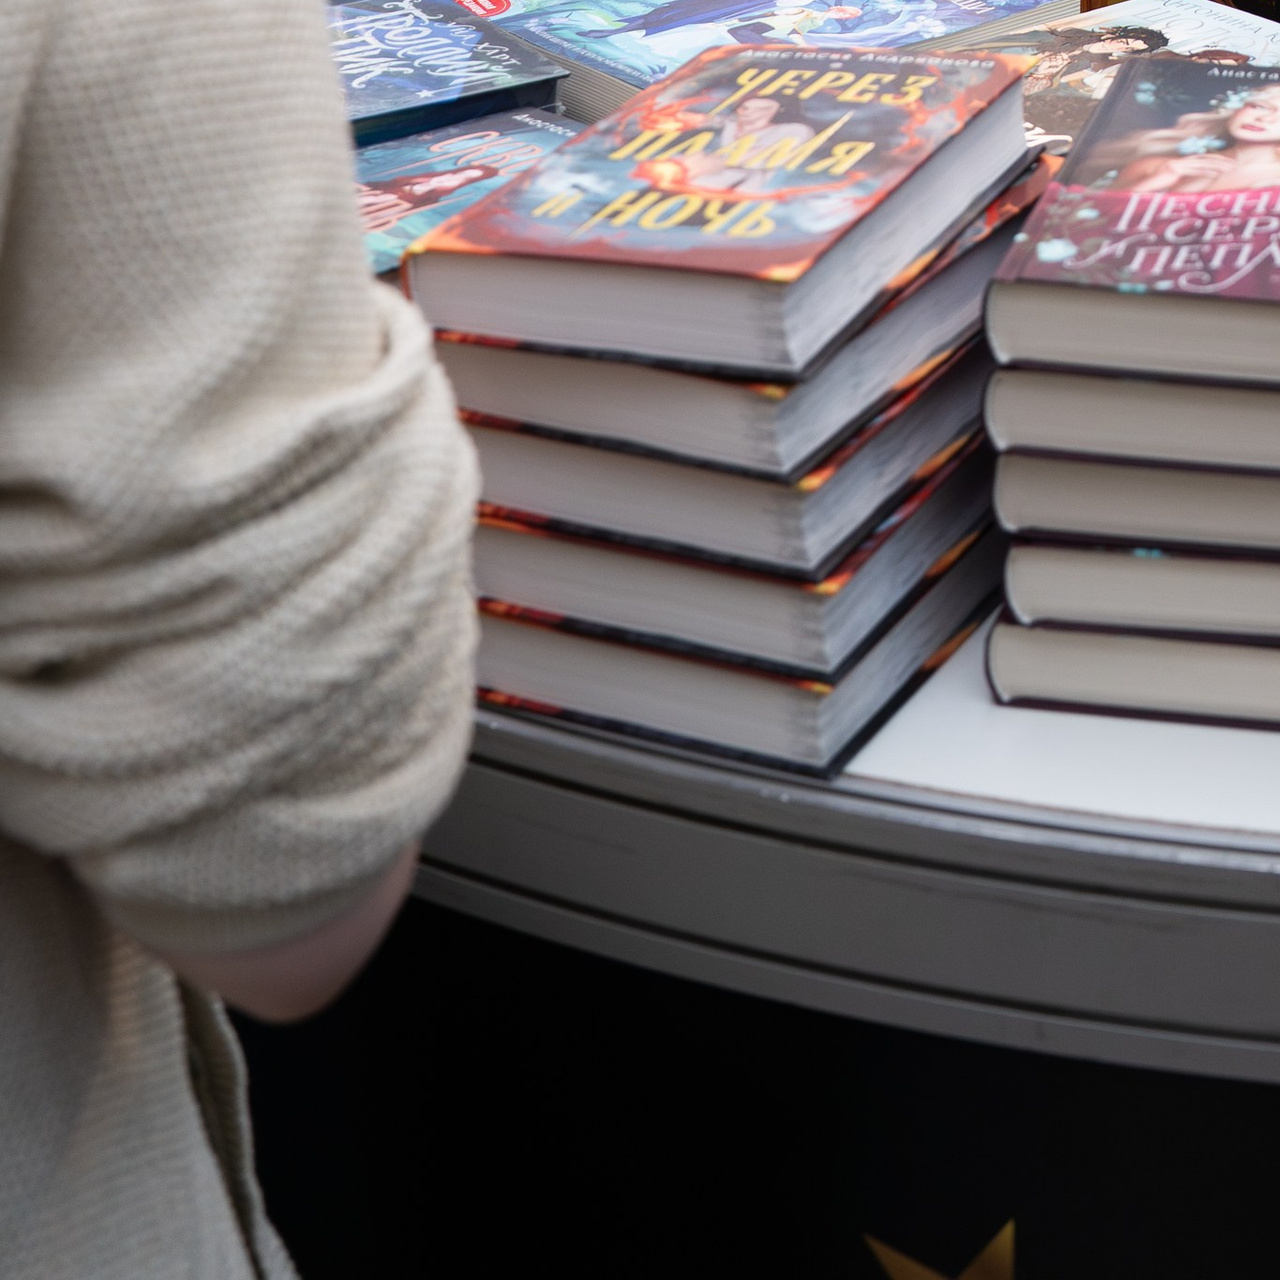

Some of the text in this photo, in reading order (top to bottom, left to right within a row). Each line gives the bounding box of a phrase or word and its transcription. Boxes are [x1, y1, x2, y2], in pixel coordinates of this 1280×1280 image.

[709, 67, 941, 117] ЧЕРЕЗ
[608, 112, 877, 176] ПЛАМЯ
[568, 190, 776, 238] НОЧЬ
